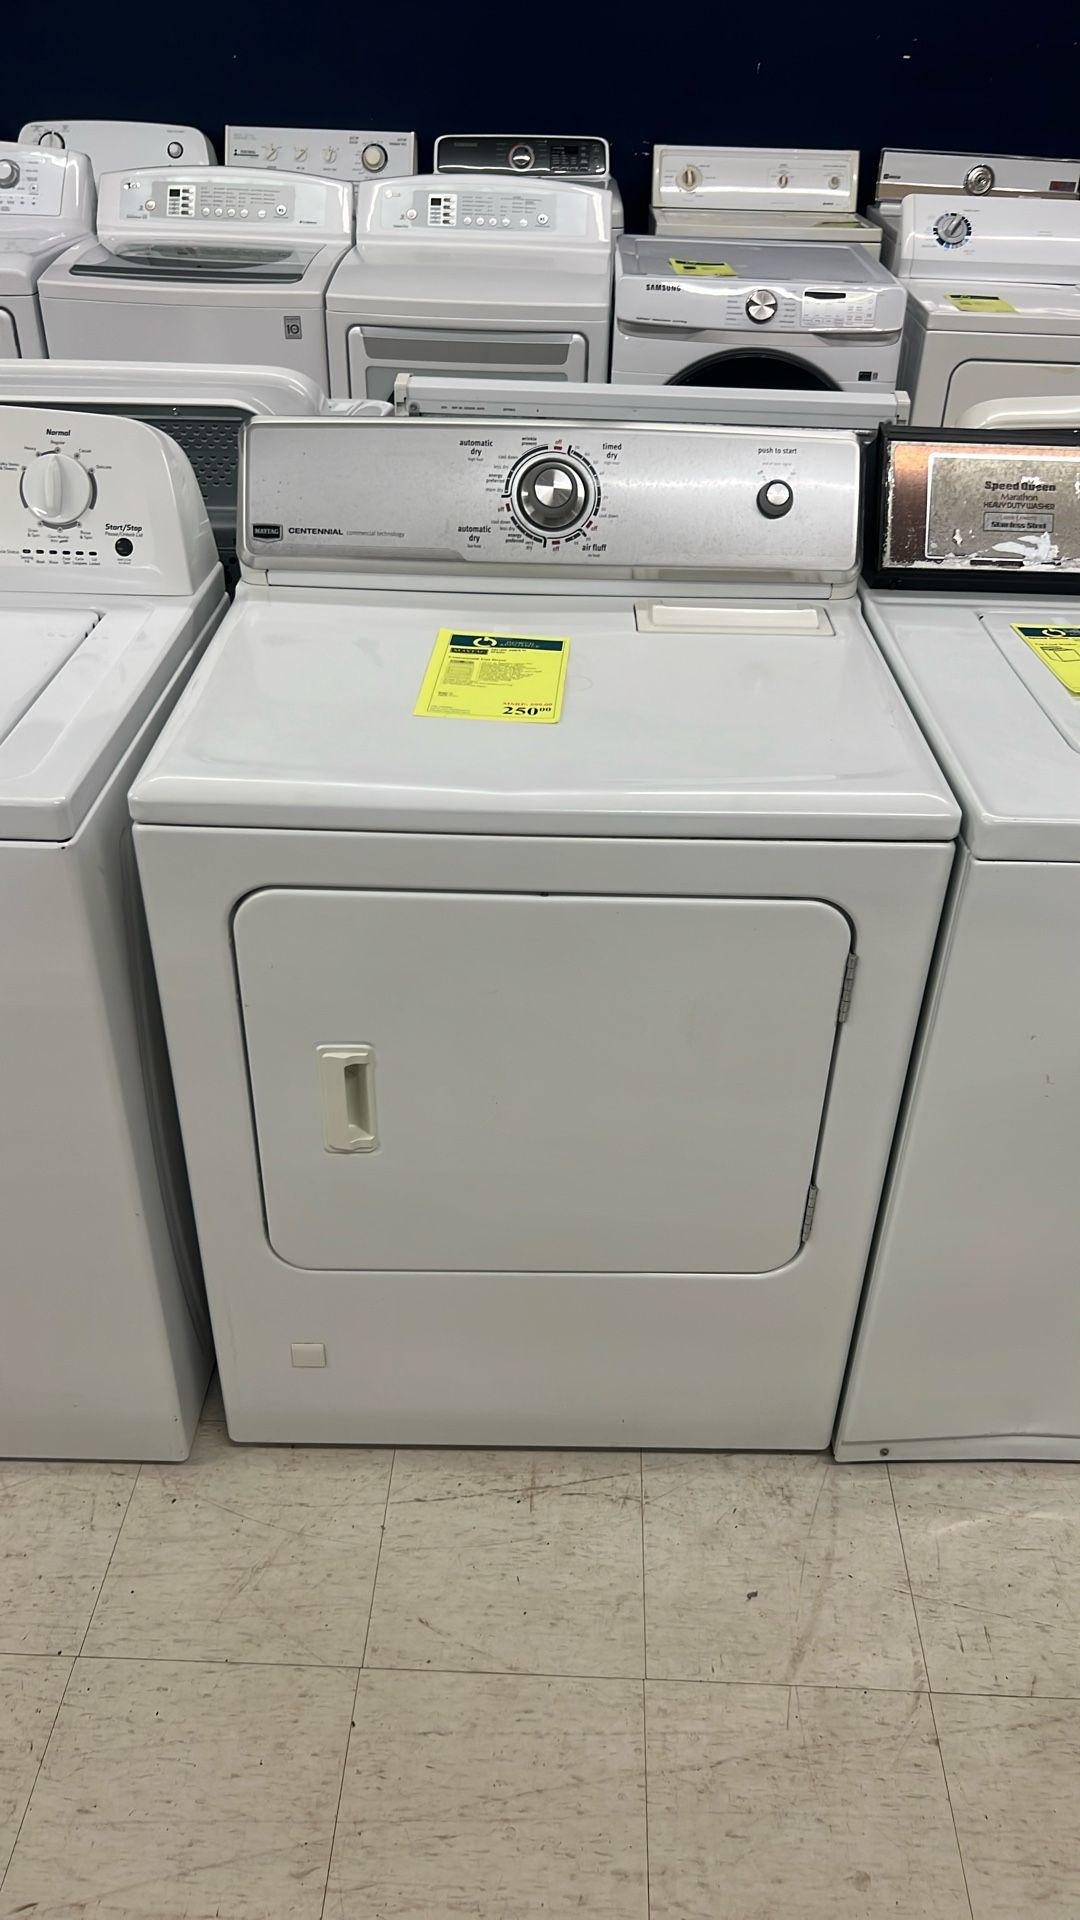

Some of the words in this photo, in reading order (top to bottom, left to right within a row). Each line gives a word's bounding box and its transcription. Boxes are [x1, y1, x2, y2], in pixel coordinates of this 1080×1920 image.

[646, 284, 681, 292] SAMSUNG
[46, 428, 71, 437] Normal
[459, 439, 493, 447] automatic
[470, 448, 482, 456] dry
[607, 452, 618, 460] dry
[984, 481, 1019, 491] Speed
[1021, 481, 1056, 492] Queen
[1000, 493, 1039, 502] Marathon
[983, 501, 1006, 509] HEAVY
[105, 523, 143, 532] Start/Stop
[990, 521, 1025, 529] Stainless
[254, 527, 280, 535] MAYTAG
[288, 527, 344, 536] CENTENNIAL
[377, 530, 405, 538] technology
[469, 534, 481, 543] dry
[582, 544, 591, 552] air
[592, 544, 607, 552] fluff
